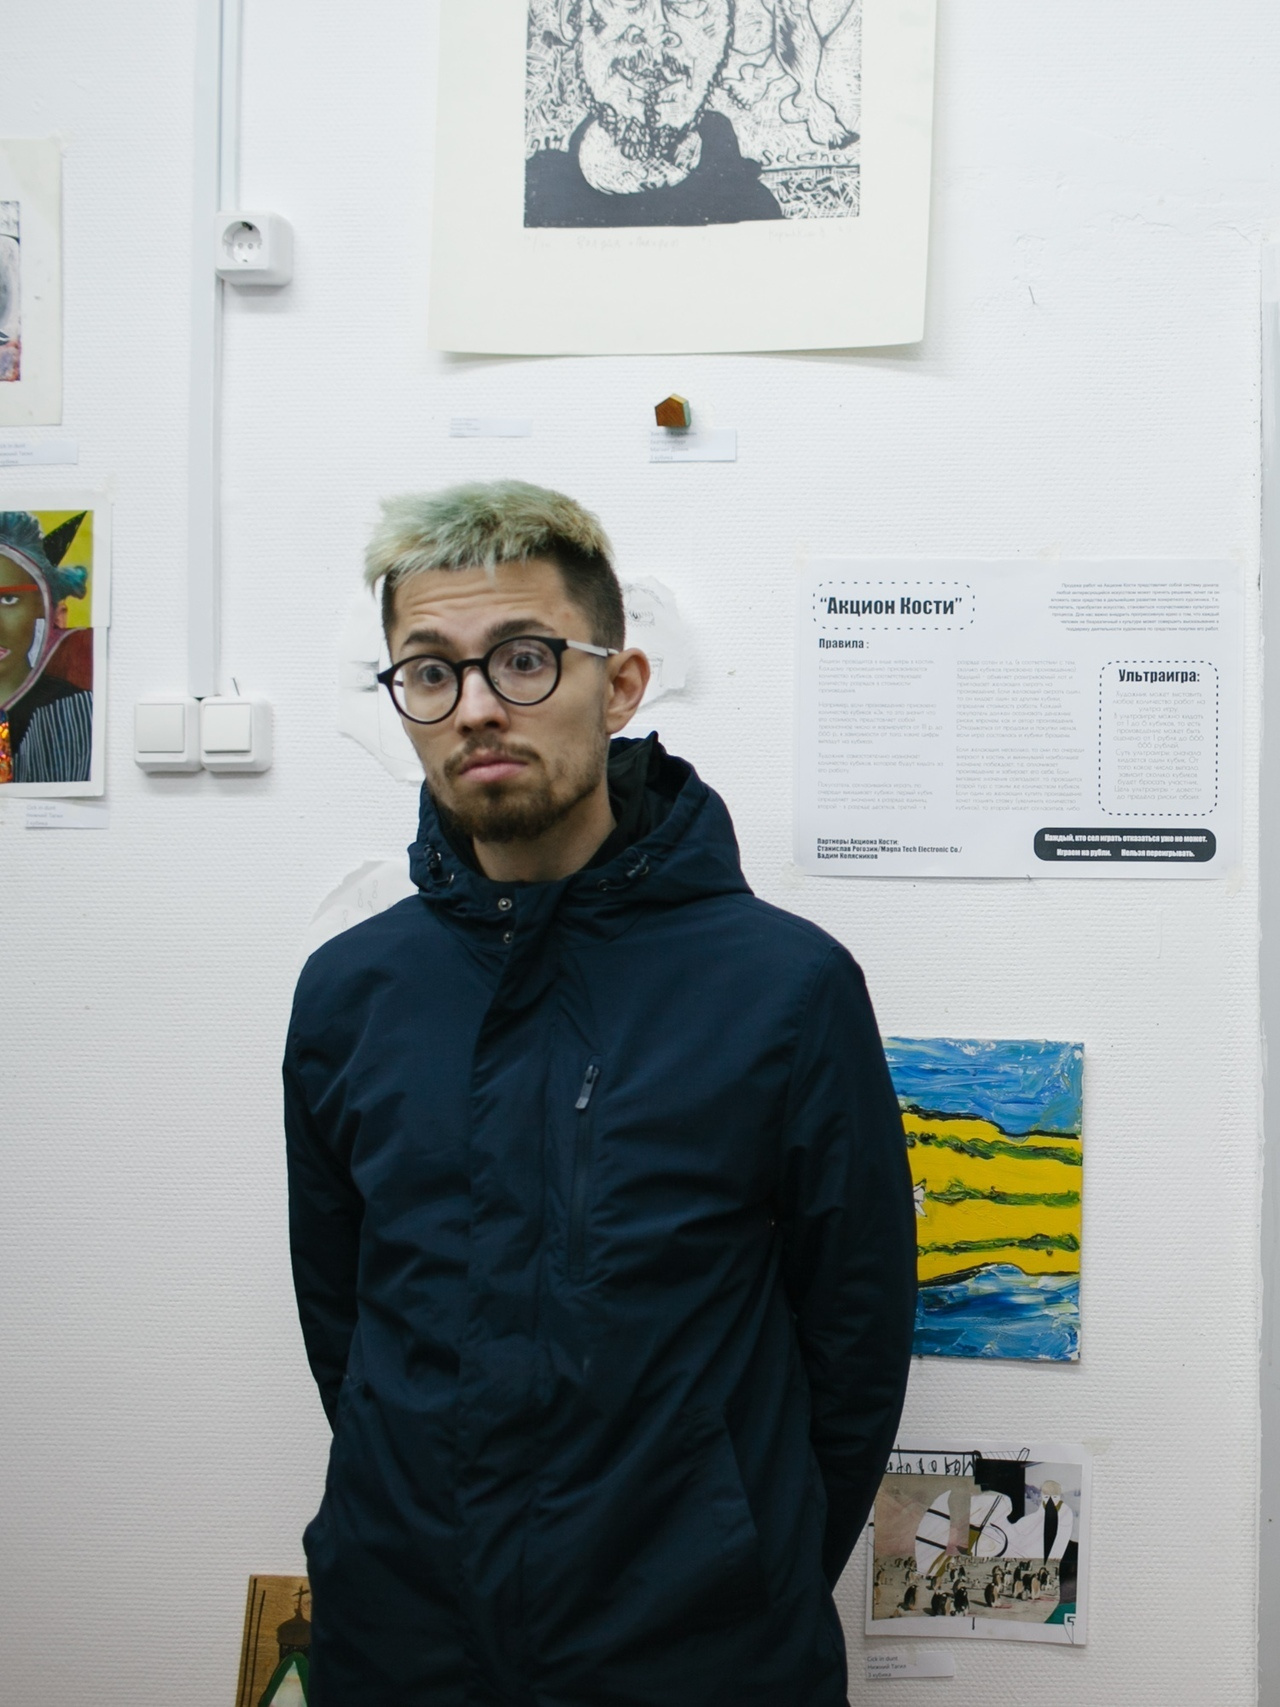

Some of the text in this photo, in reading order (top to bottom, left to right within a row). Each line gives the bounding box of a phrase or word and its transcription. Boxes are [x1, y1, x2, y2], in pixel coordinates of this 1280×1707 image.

[1118, 668, 1201, 684] Ультраигра:
[817, 838, 849, 846] Партнеры
[1100, 835, 1122, 843] играть
[1057, 849, 1080, 857] Играем
[1121, 849, 1145, 857] Нельзя
